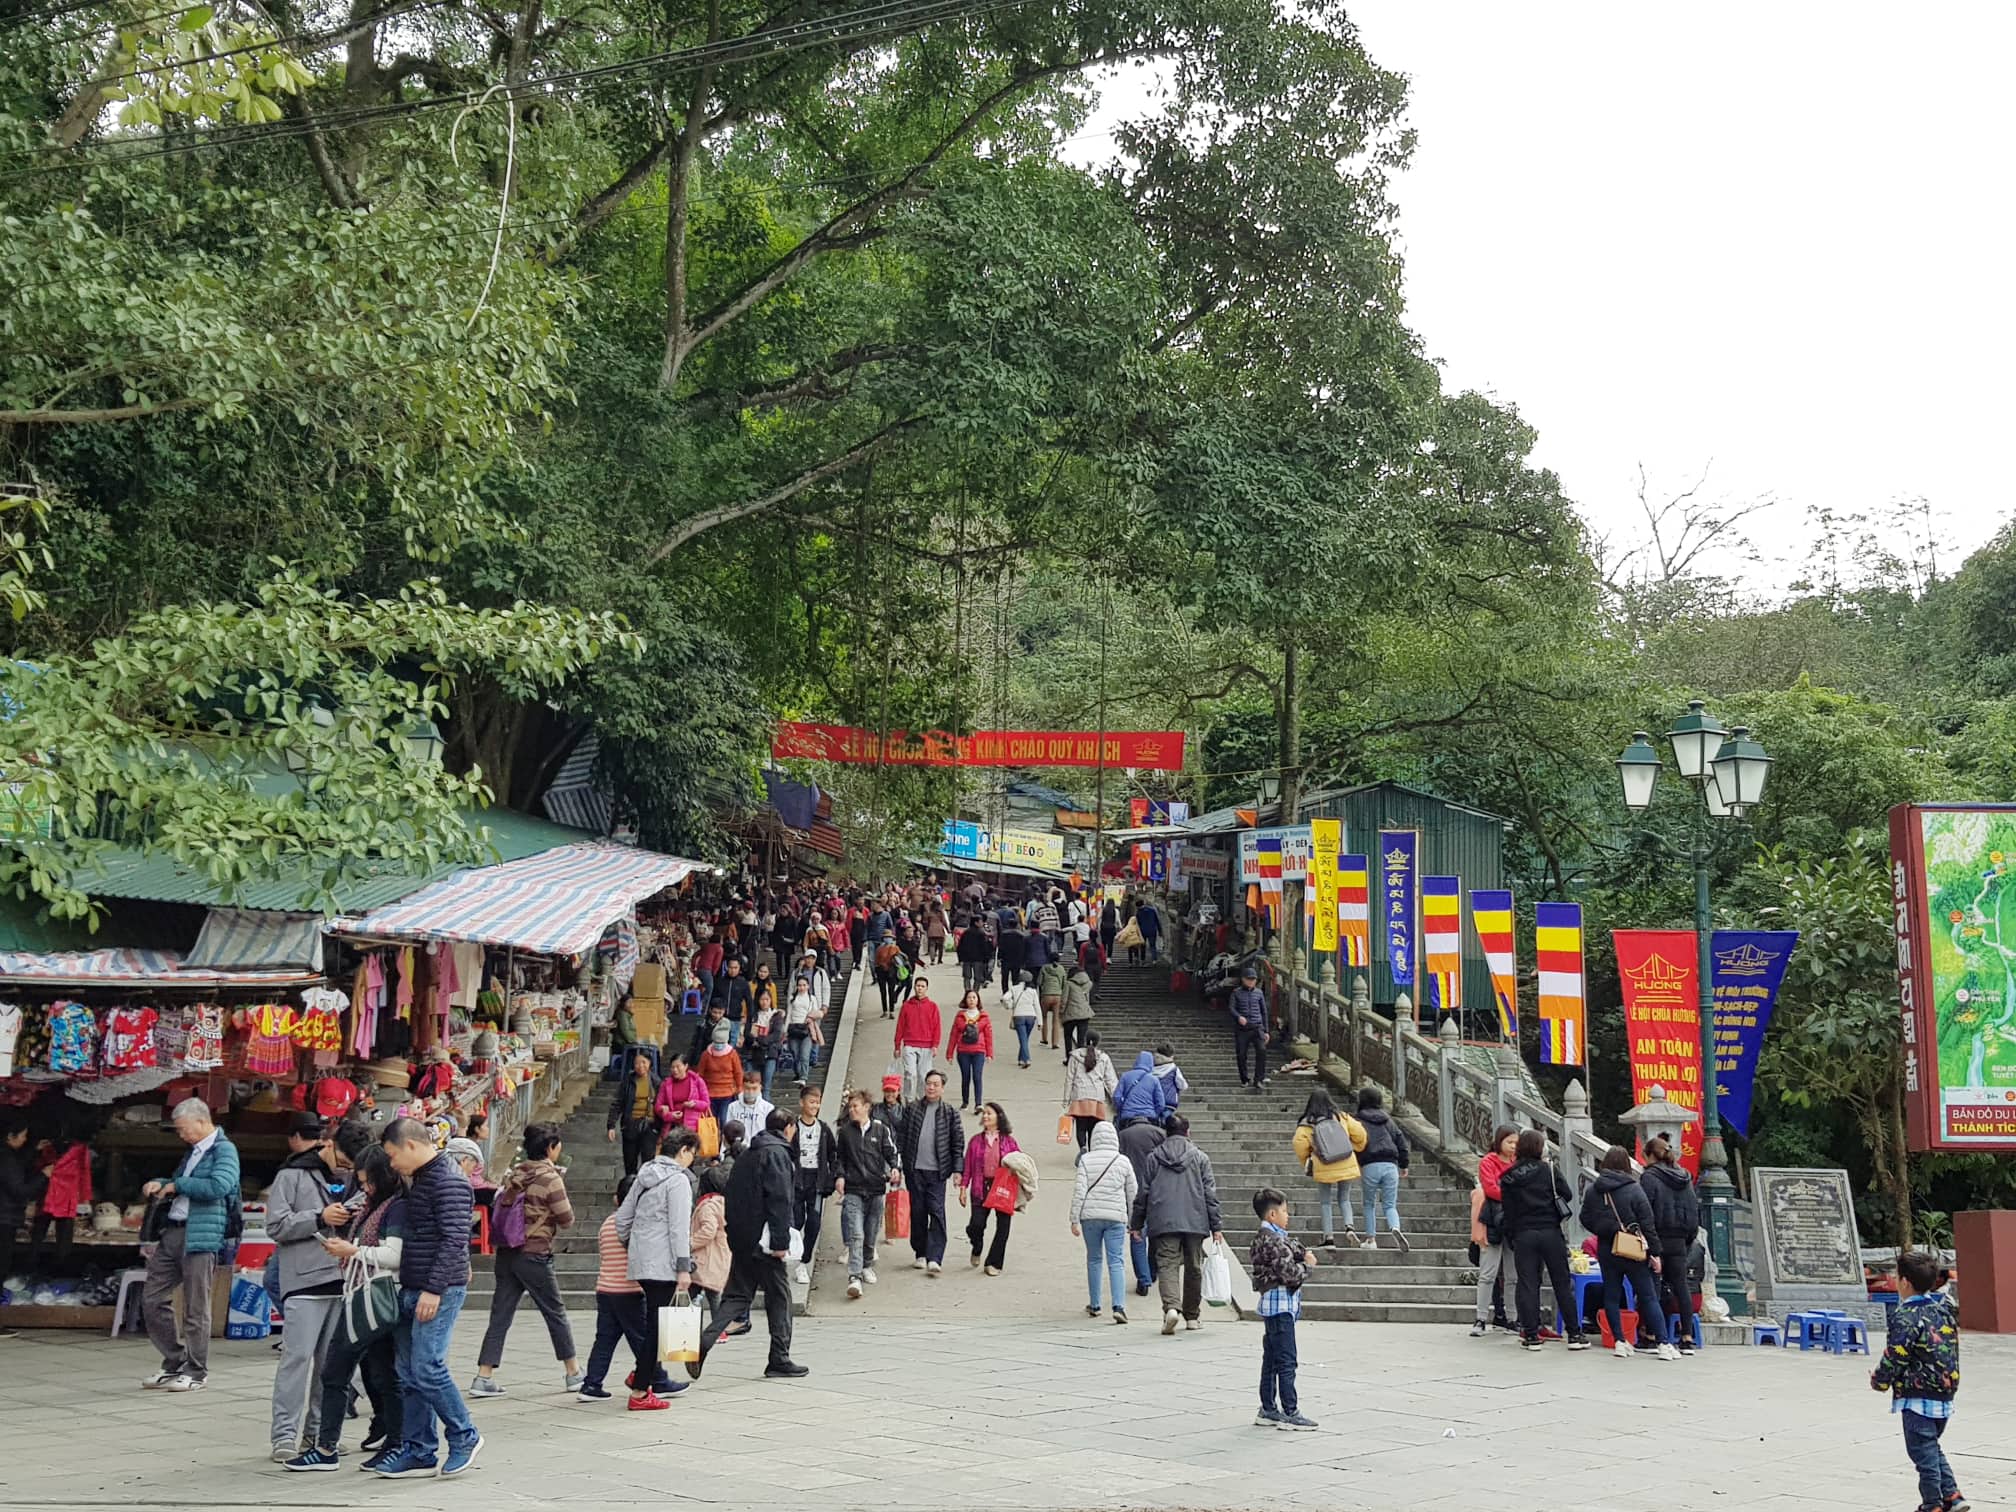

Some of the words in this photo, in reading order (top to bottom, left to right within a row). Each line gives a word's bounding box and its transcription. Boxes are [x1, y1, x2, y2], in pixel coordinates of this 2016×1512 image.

[1010, 735, 1045, 760] CHÀO
[1048, 736, 1074, 761] QUÝ
[1636, 1039, 1656, 1055] AN
[1659, 1037, 1694, 1058] TOÀN
[1635, 1061, 1679, 1084] THUẬN
[1952, 1107, 1975, 1119] BẢN
[1977, 1106, 1993, 1119] ĐỒ
[1995, 1109, 2010, 1119] DU
